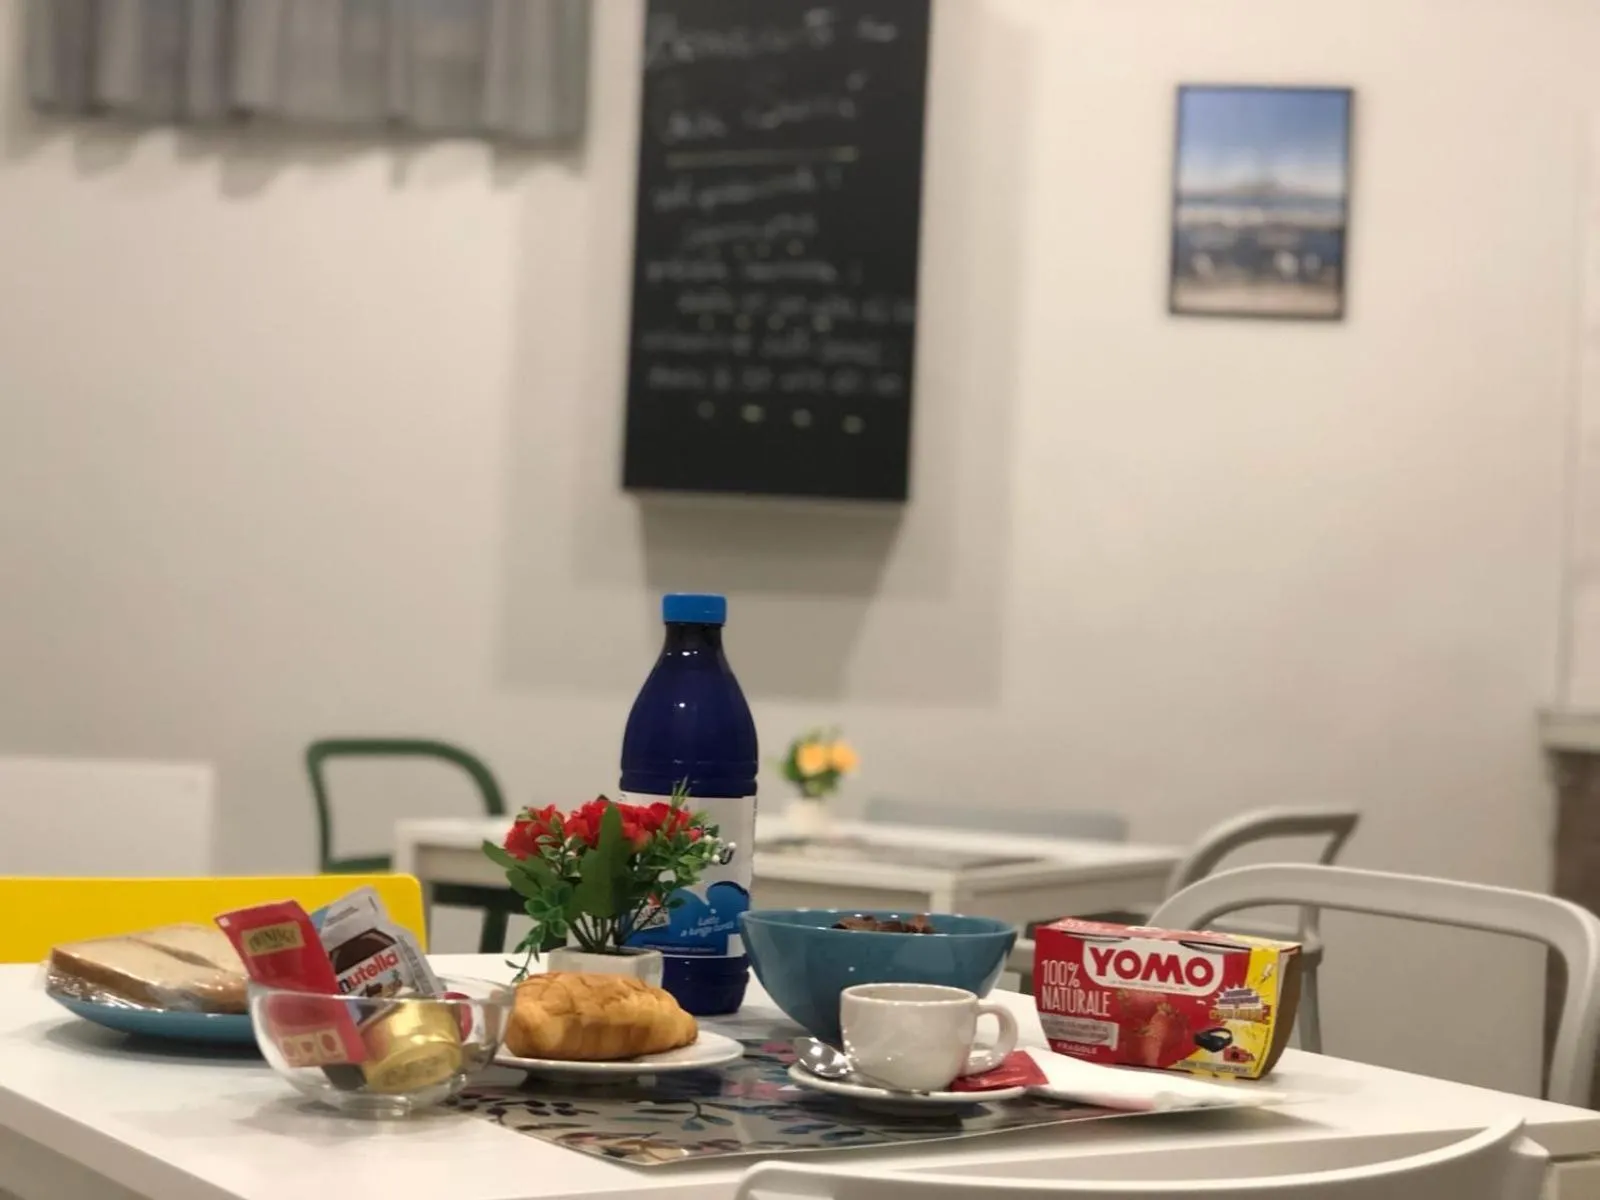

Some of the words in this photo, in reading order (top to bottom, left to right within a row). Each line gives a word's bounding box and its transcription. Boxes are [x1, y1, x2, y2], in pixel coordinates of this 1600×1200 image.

[338, 950, 399, 994] nutella
[1041, 959, 1081, 988] 100%
[1088, 946, 1215, 988] YOMO
[1041, 984, 1113, 1018] NATURALE
